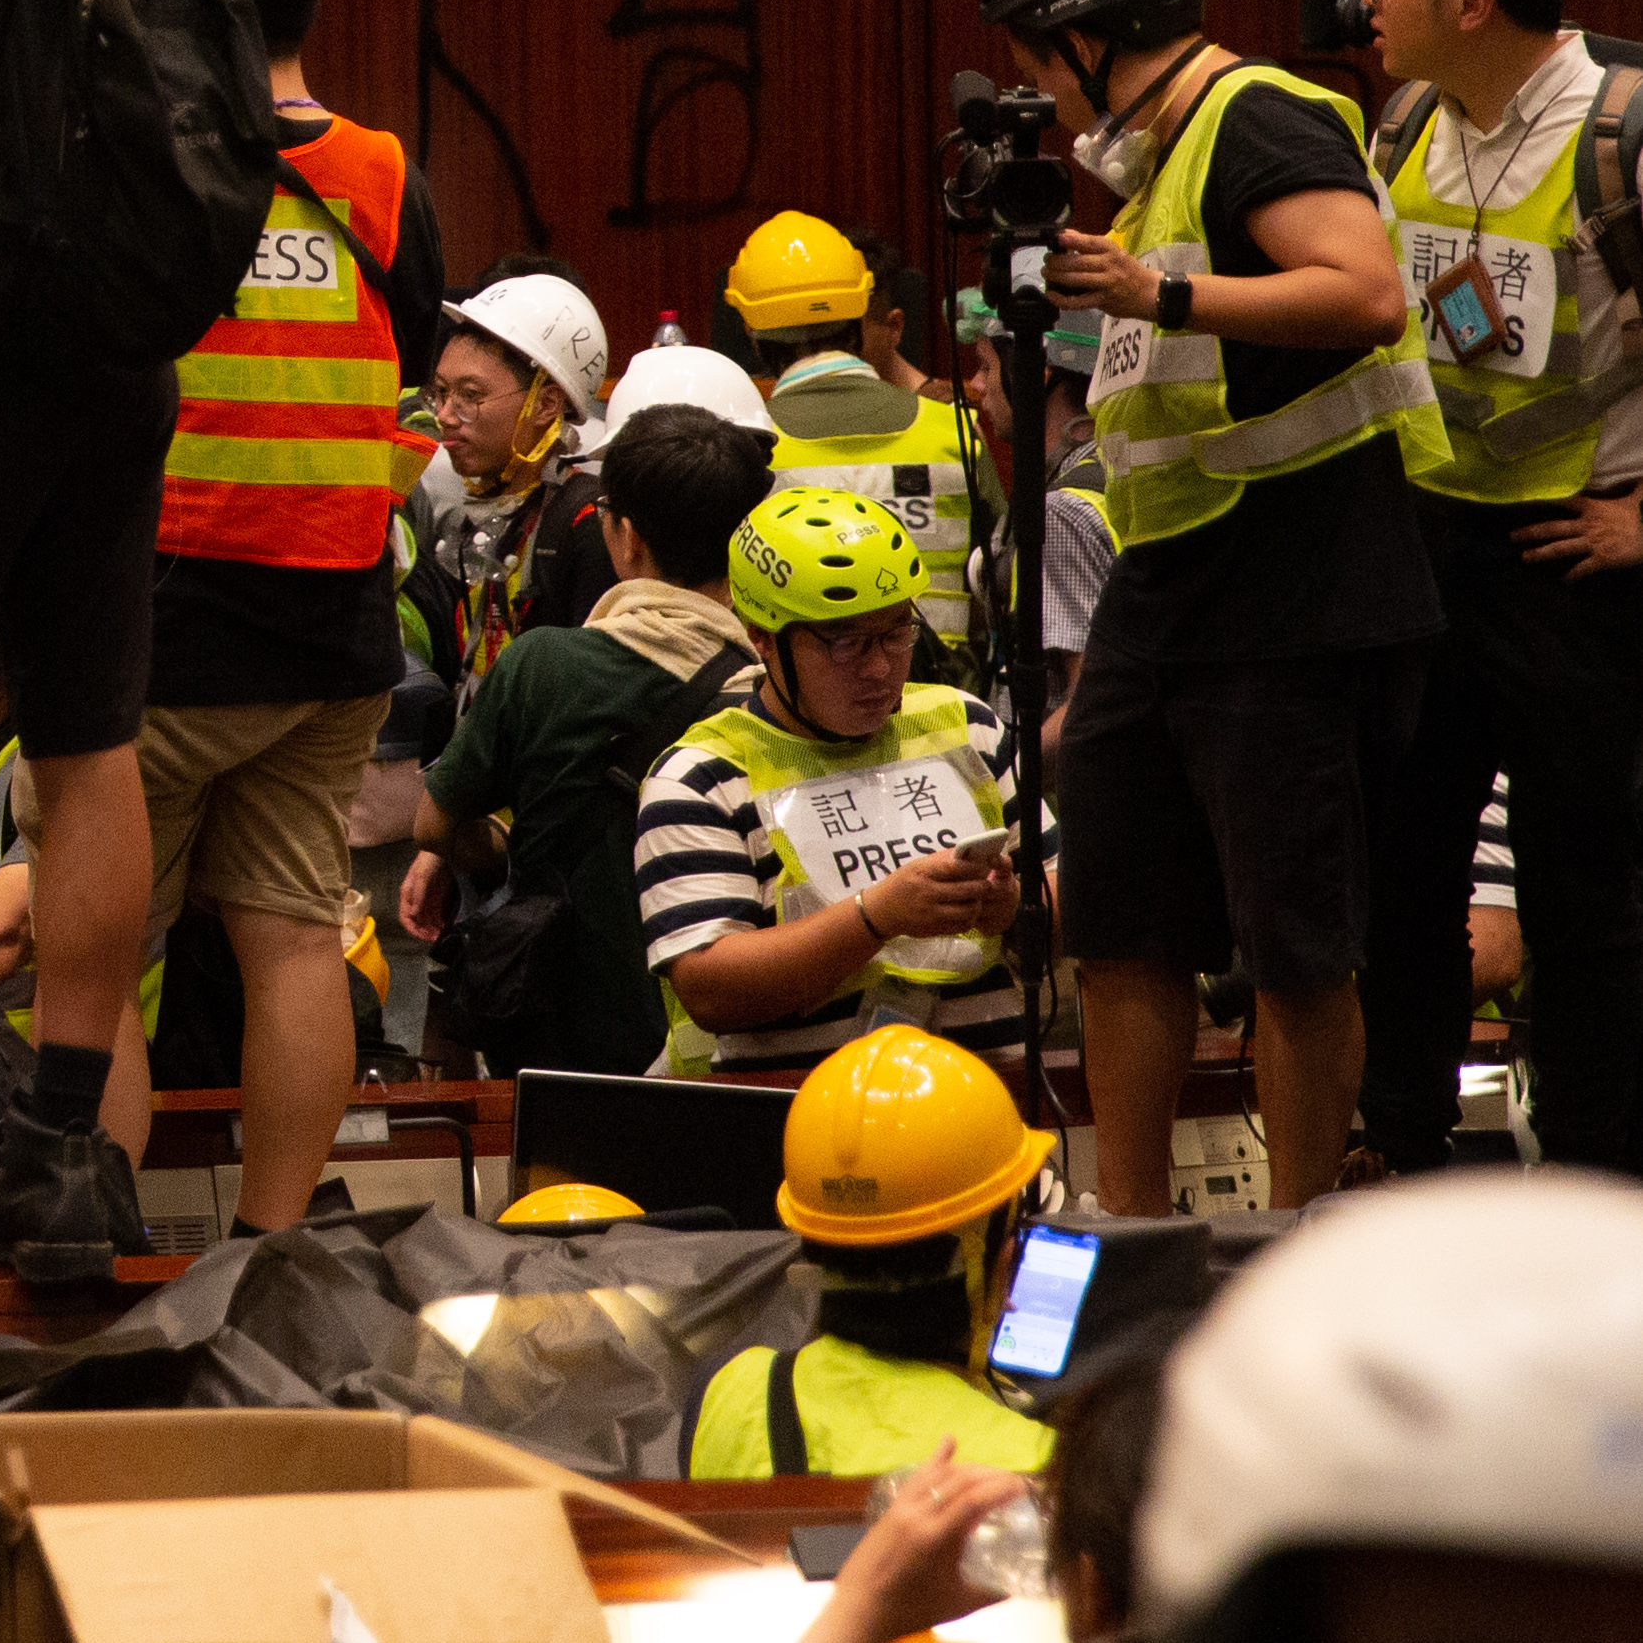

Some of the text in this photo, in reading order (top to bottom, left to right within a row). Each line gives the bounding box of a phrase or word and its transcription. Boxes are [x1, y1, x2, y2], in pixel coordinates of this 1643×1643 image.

[252, 233, 329, 283] ESS
[1413, 233, 1532, 302] 記者
[736, 516, 794, 589] PRESS
[837, 522, 881, 546] Press
[810, 774, 943, 839] 記者
